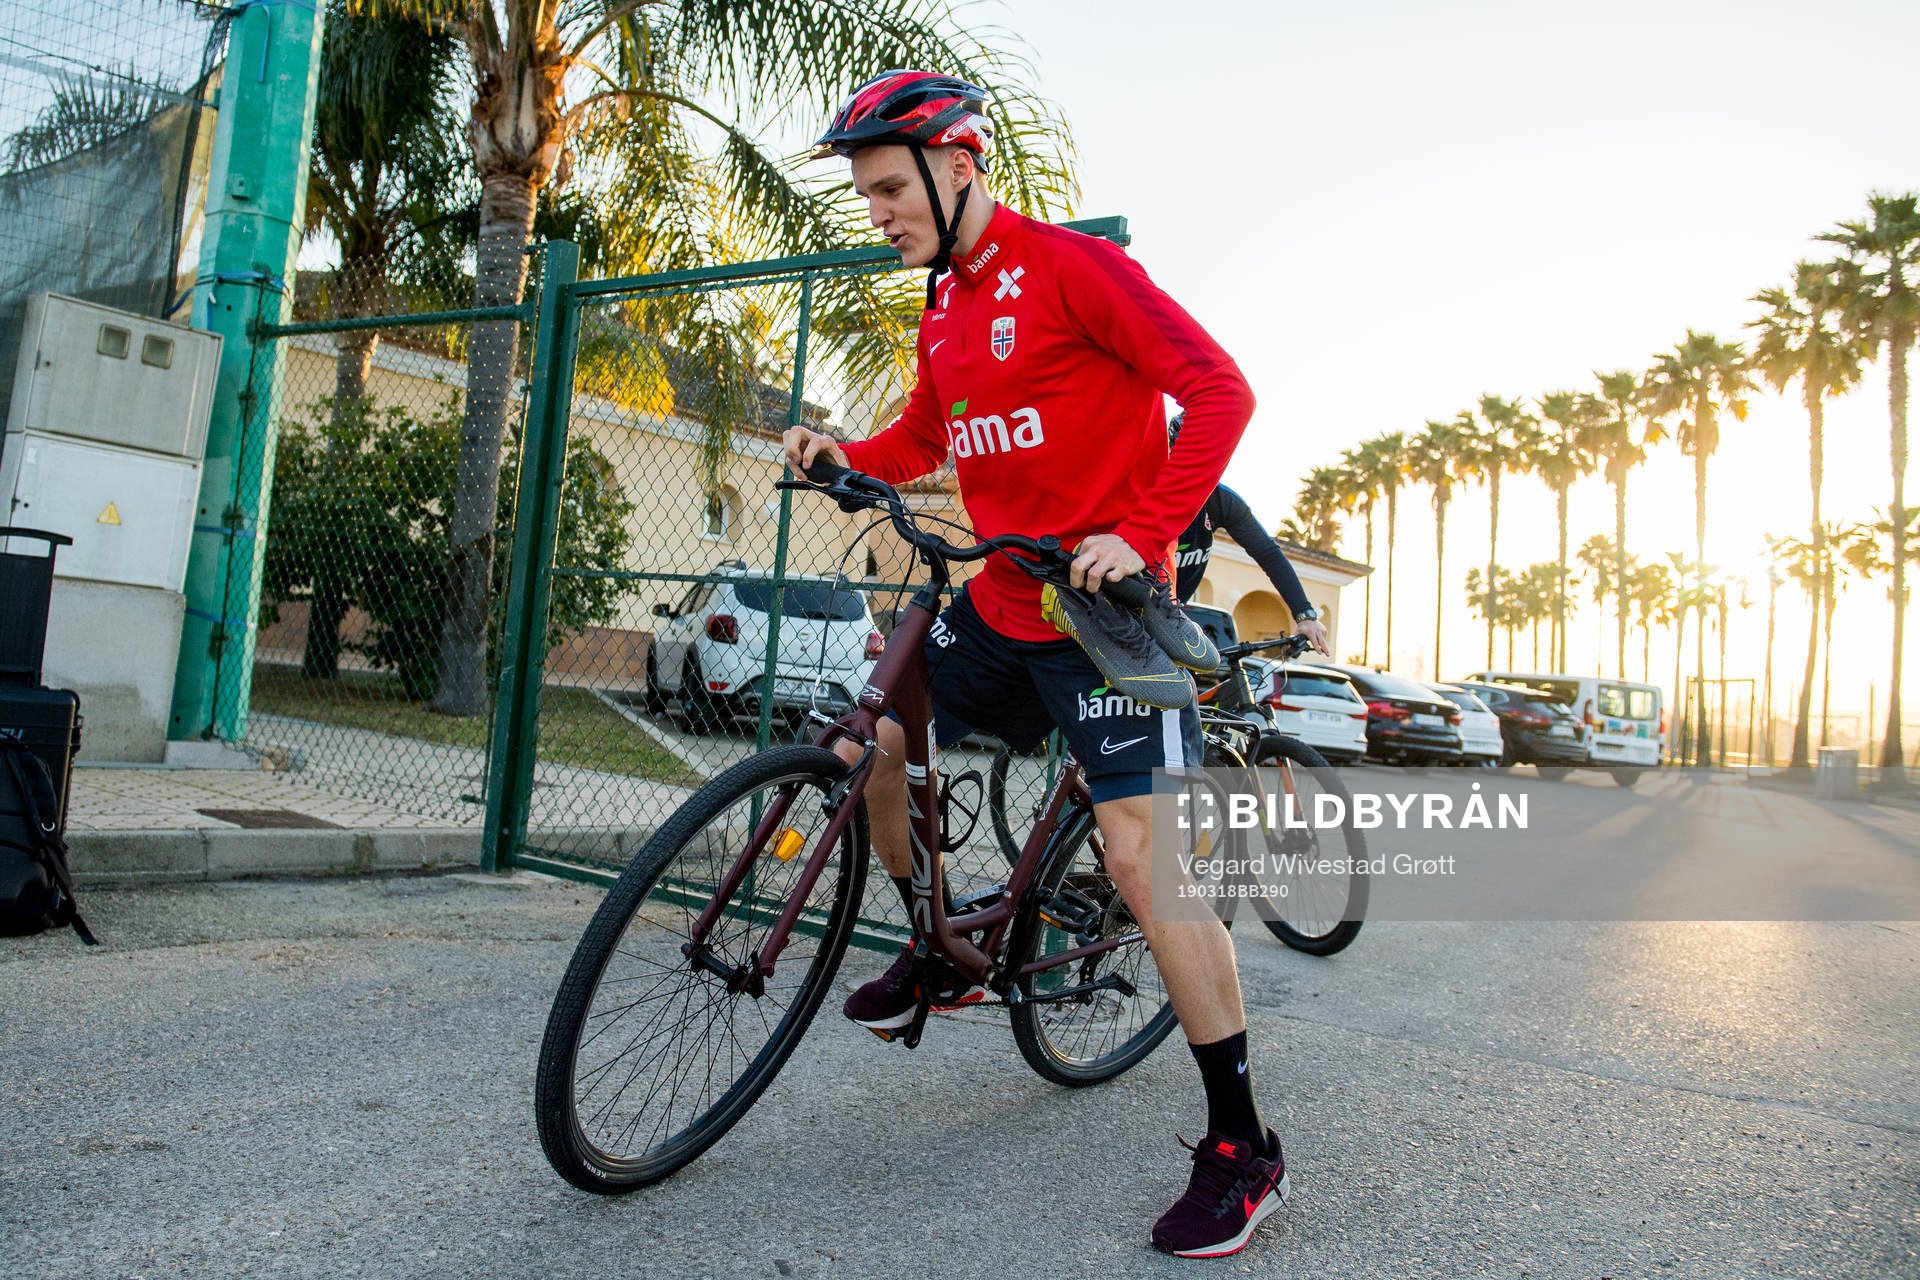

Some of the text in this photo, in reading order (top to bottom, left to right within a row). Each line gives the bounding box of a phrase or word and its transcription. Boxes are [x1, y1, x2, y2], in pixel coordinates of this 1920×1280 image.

[966, 243, 1000, 274] bama
[1175, 548, 1213, 568] ama
[1078, 692, 1151, 721] bama
[583, 1158, 607, 1179] KENDA
